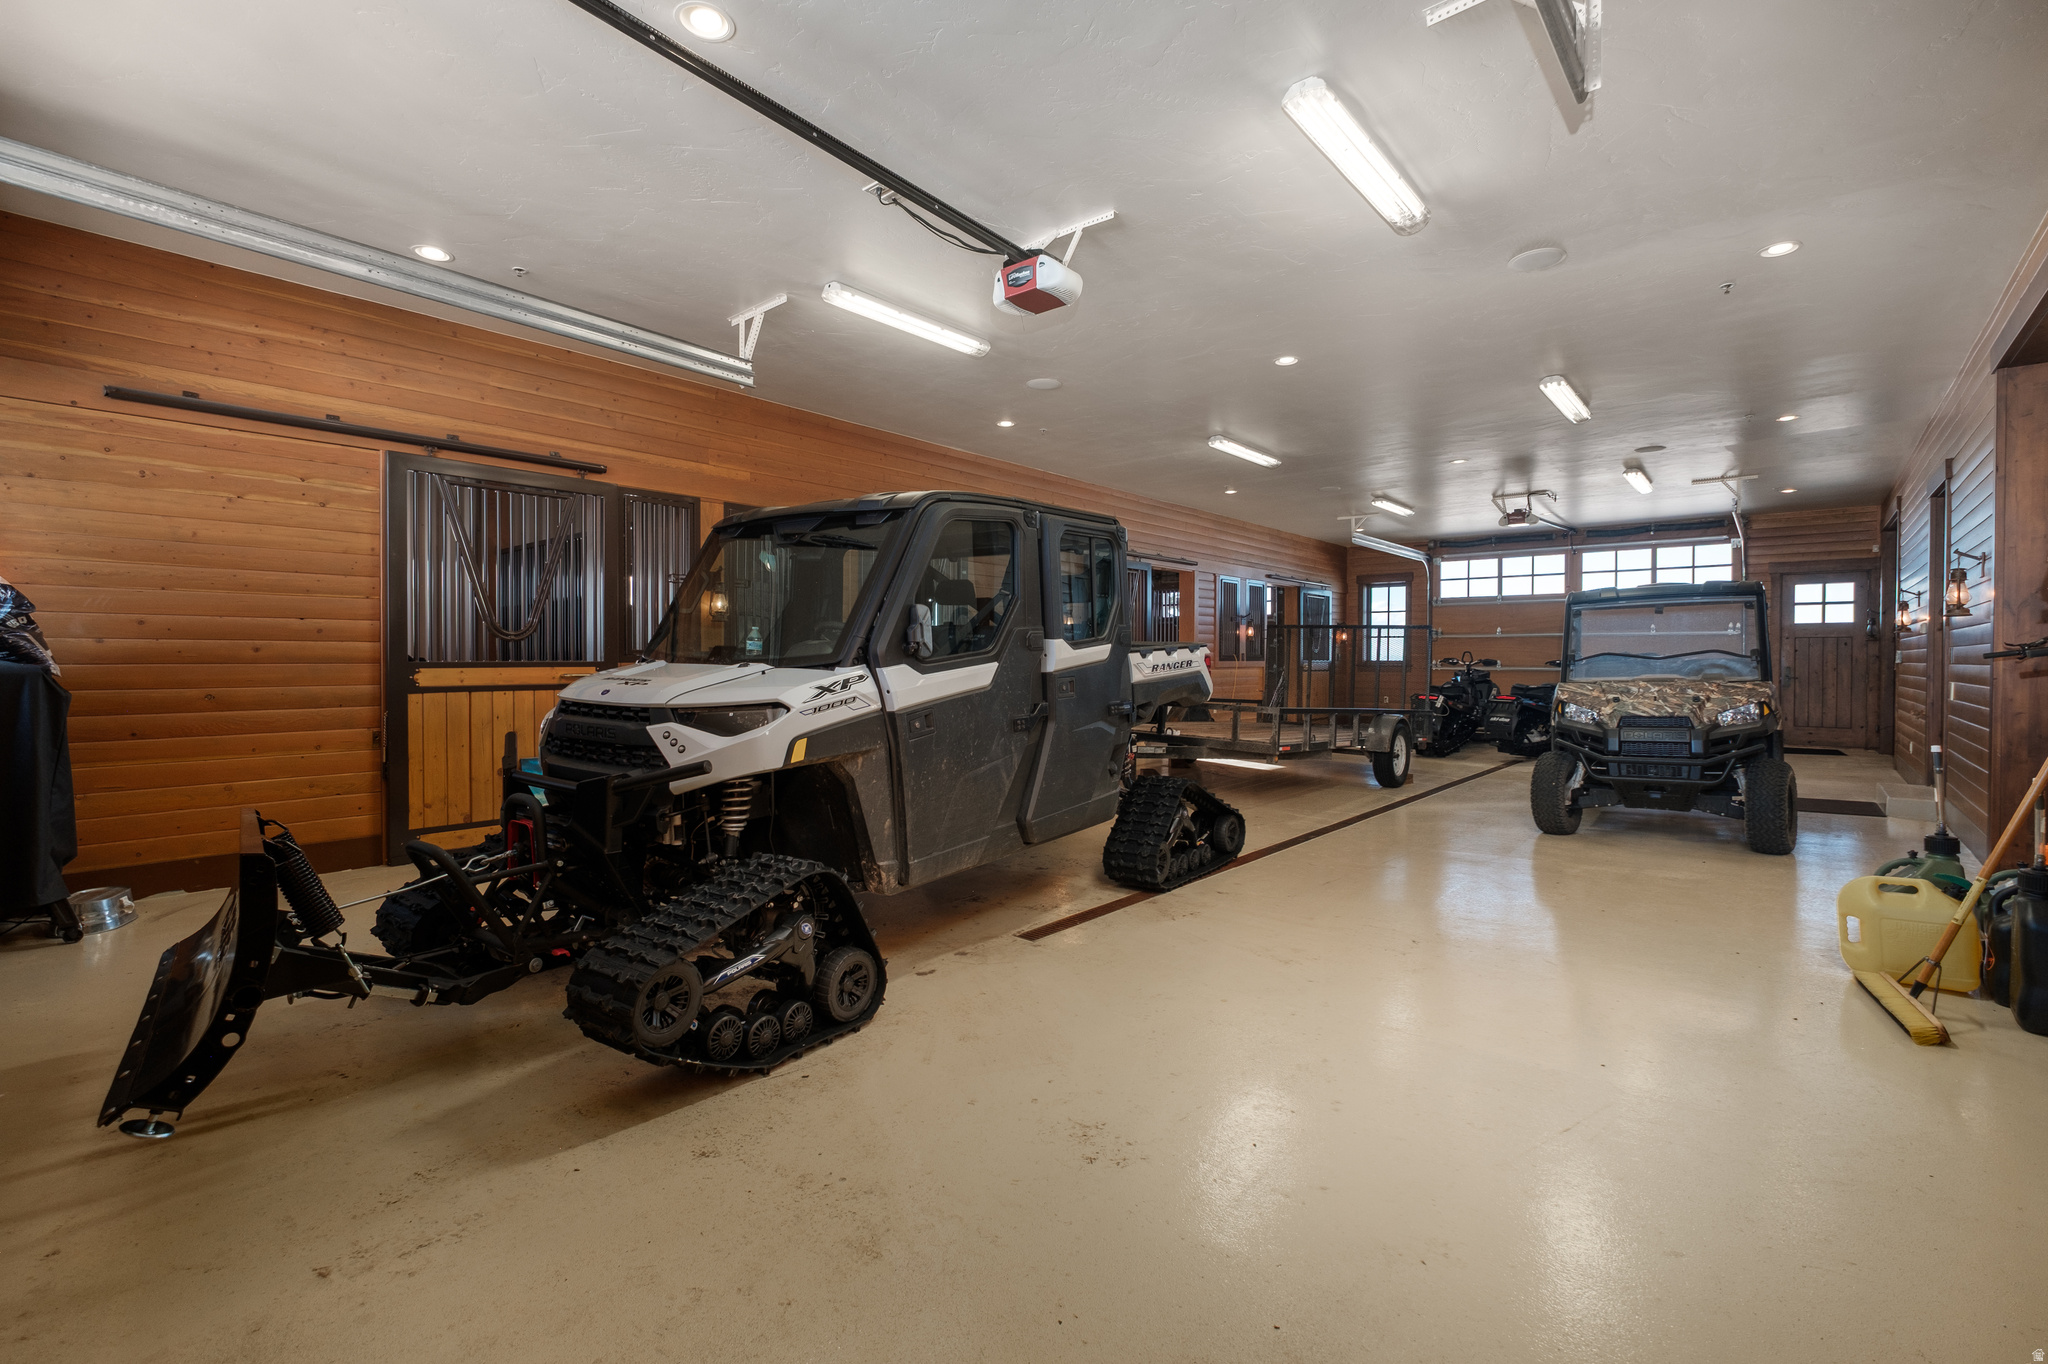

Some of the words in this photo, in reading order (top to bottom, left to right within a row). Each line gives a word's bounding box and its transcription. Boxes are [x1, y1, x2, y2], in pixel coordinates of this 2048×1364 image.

[1151, 660, 1193, 672] RANGER
[803, 674, 869, 704] XP
[811, 696, 856, 714] 1000
[565, 723, 616, 738] POLARIS
[1623, 731, 1688, 741] POLARIS
